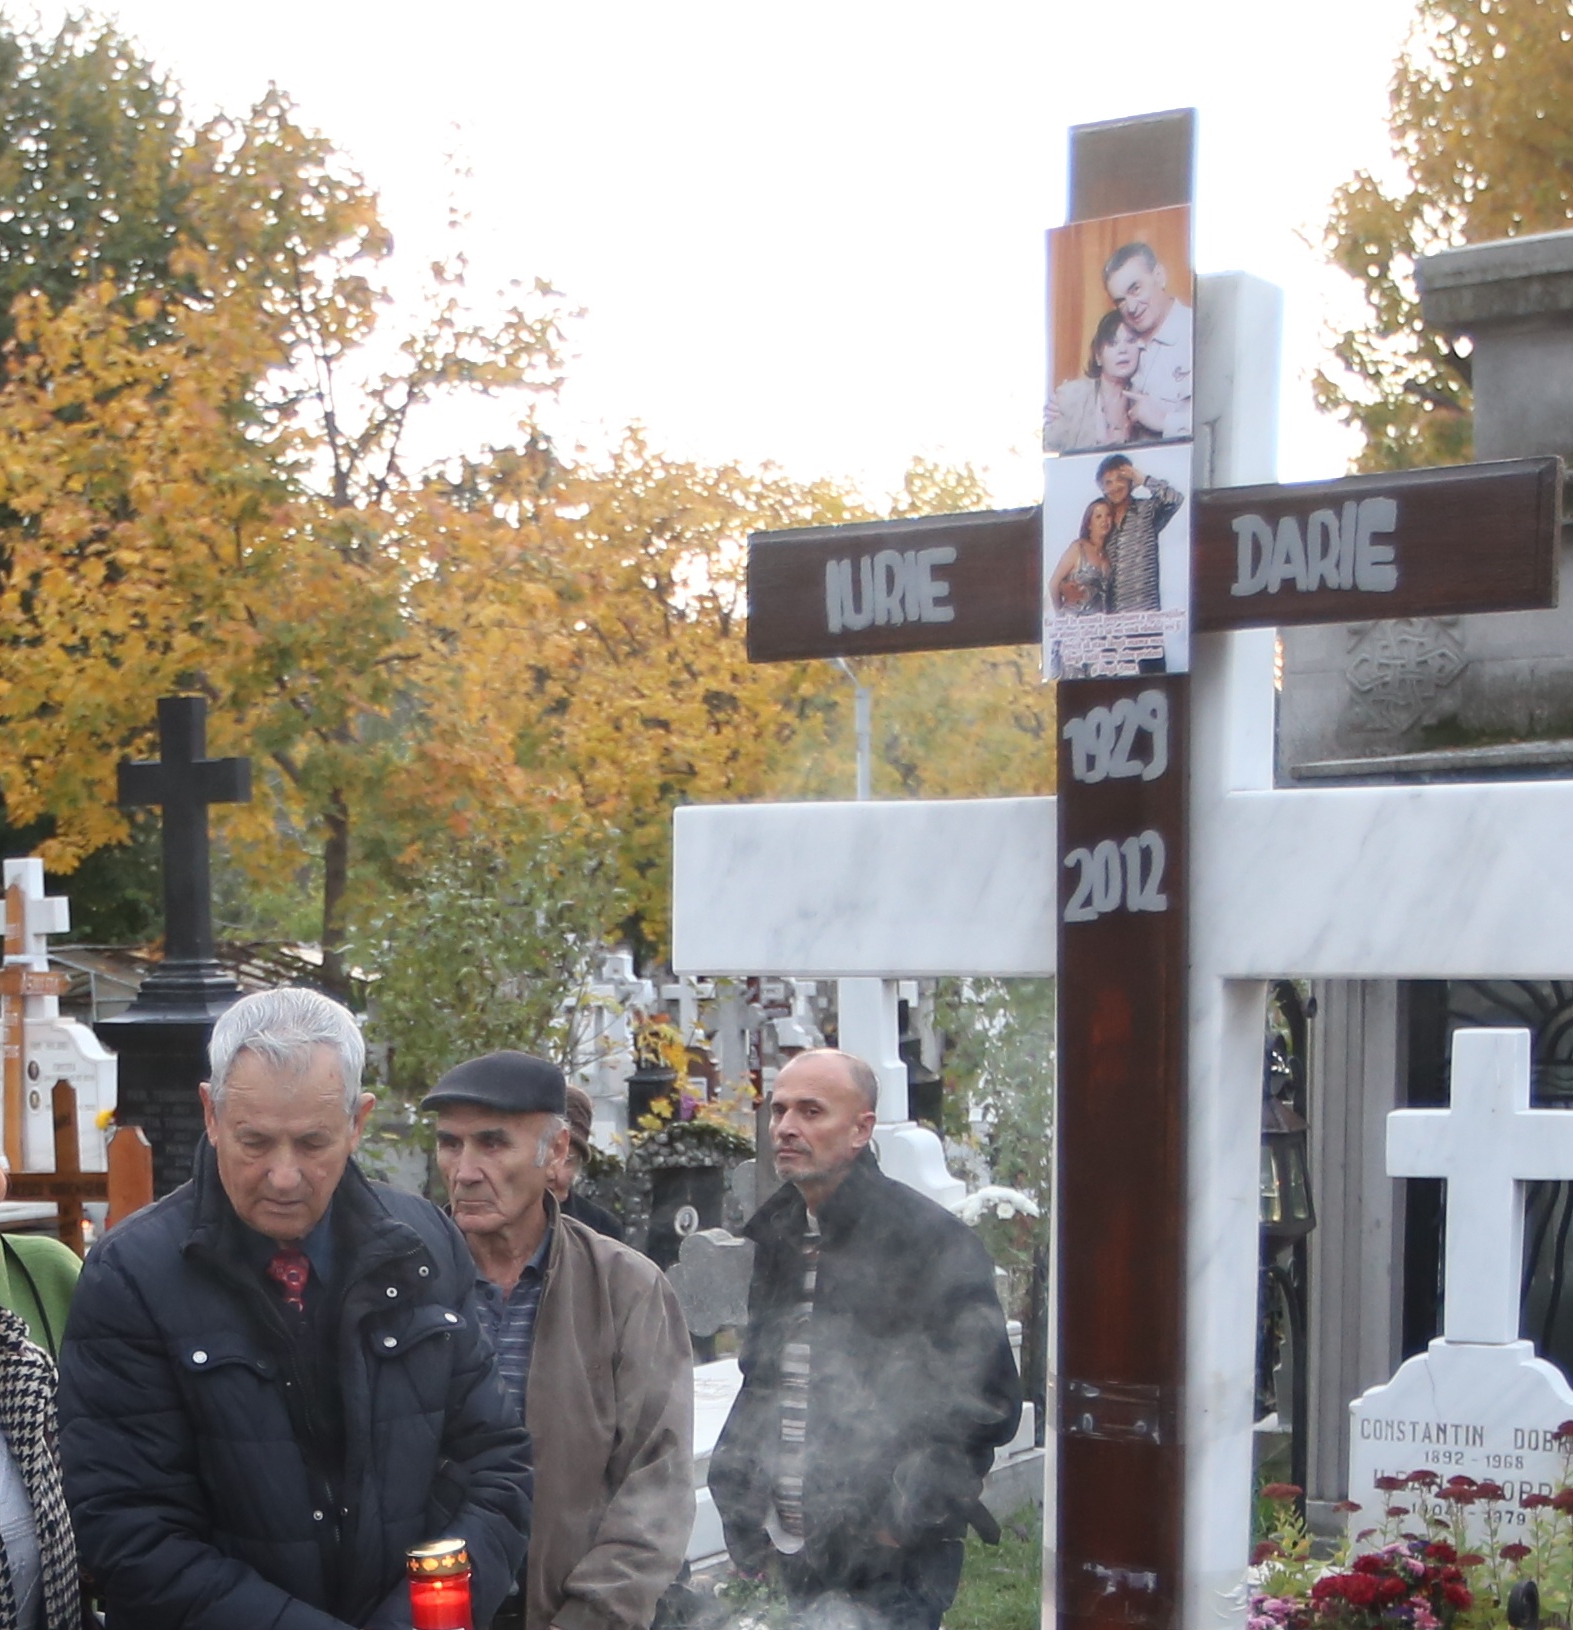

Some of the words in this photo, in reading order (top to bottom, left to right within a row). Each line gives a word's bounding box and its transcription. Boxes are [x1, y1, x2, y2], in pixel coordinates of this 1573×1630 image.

[826, 546, 957, 635] IURIE
[1231, 497, 1399, 598] DARIE
[1062, 690, 1170, 785] 1929
[1062, 829, 1169, 923] 2012
[1360, 1418, 1484, 1447] CONSTANTIN
[1424, 1450, 1464, 1466] 1892
[1486, 1455, 1524, 1469] 1968
